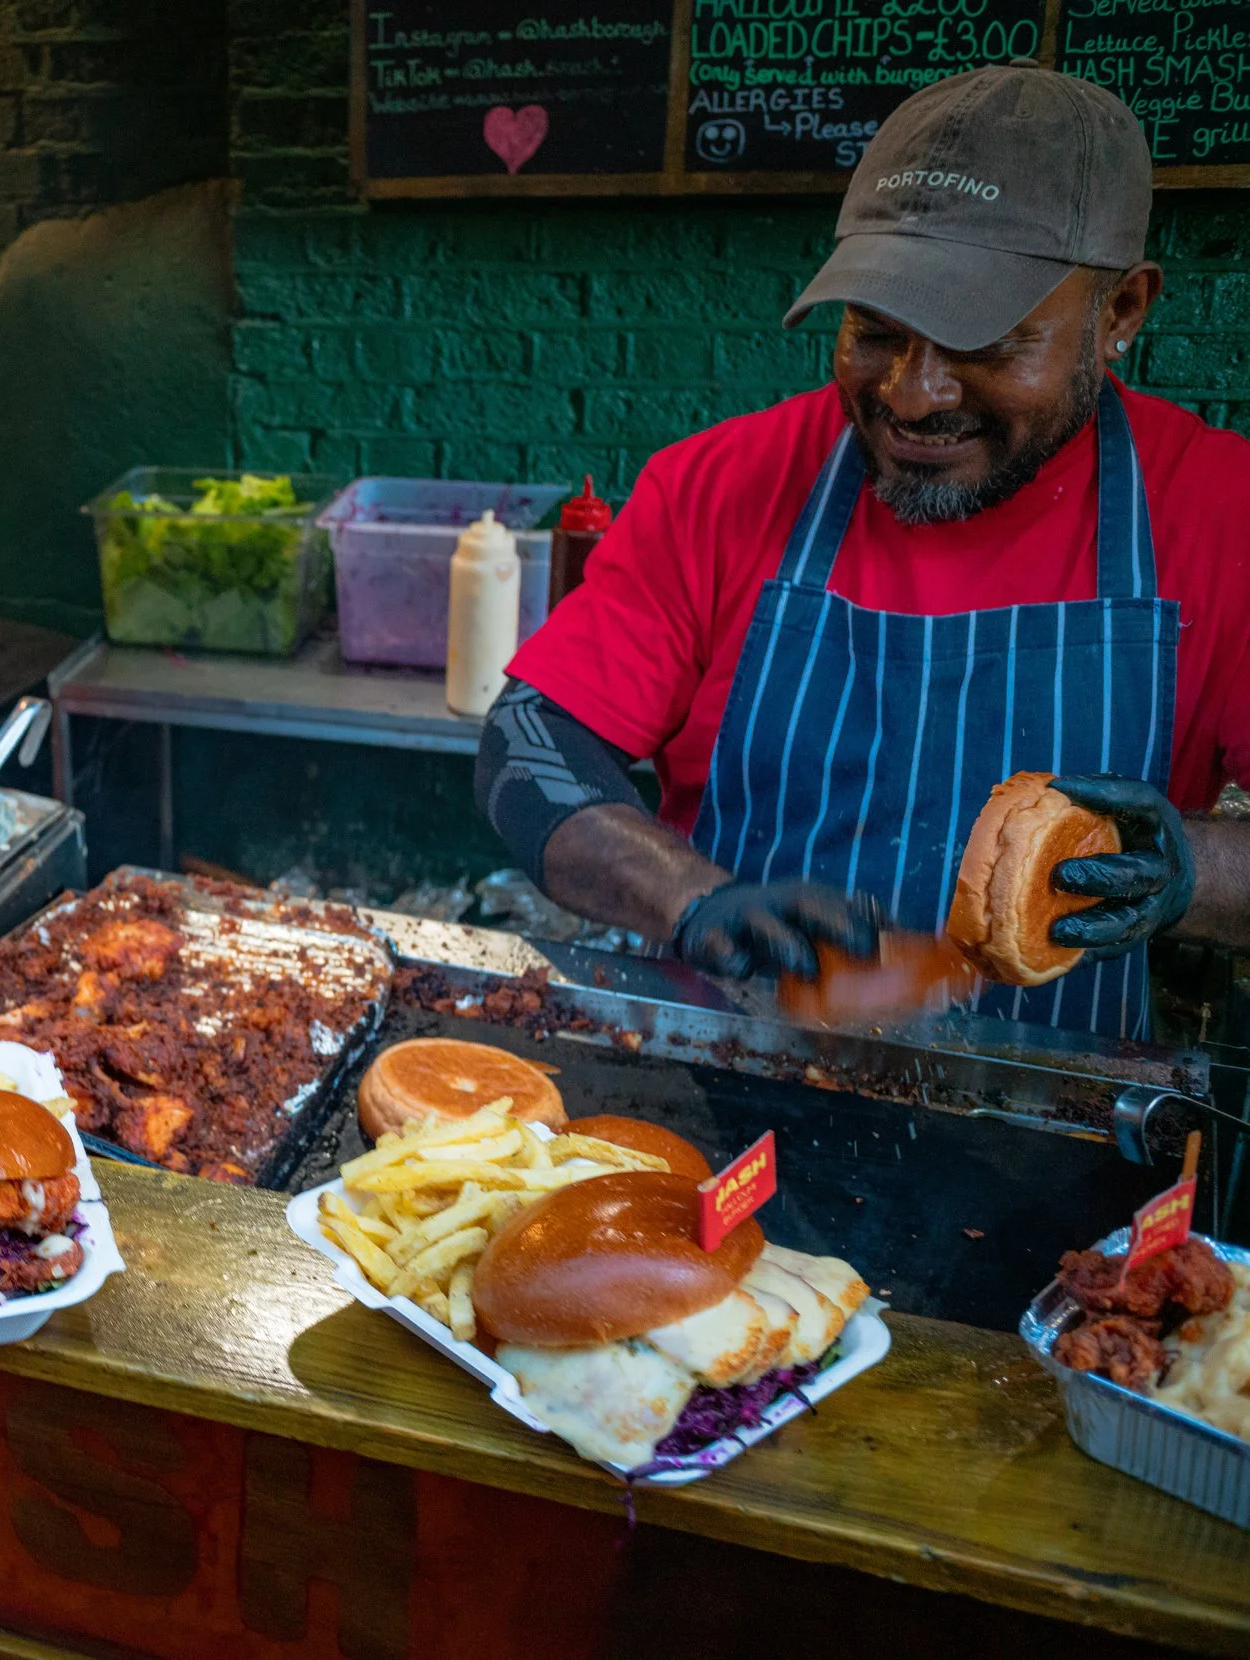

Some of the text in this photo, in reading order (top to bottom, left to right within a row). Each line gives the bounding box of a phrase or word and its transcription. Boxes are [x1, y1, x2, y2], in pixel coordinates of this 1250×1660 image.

[691, 19, 808, 59] LOADED
[811, 18, 912, 58] CHIPS
[820, 65, 871, 86] with
[1063, 56, 1135, 86] HASH
[689, 88, 845, 115] ALLERGIES
[1119, 87, 1204, 121] Veggie
[795, 113, 879, 140] Please
[876, 170, 1000, 201] PORTOFINO
[715, 1151, 767, 1212] HASH
